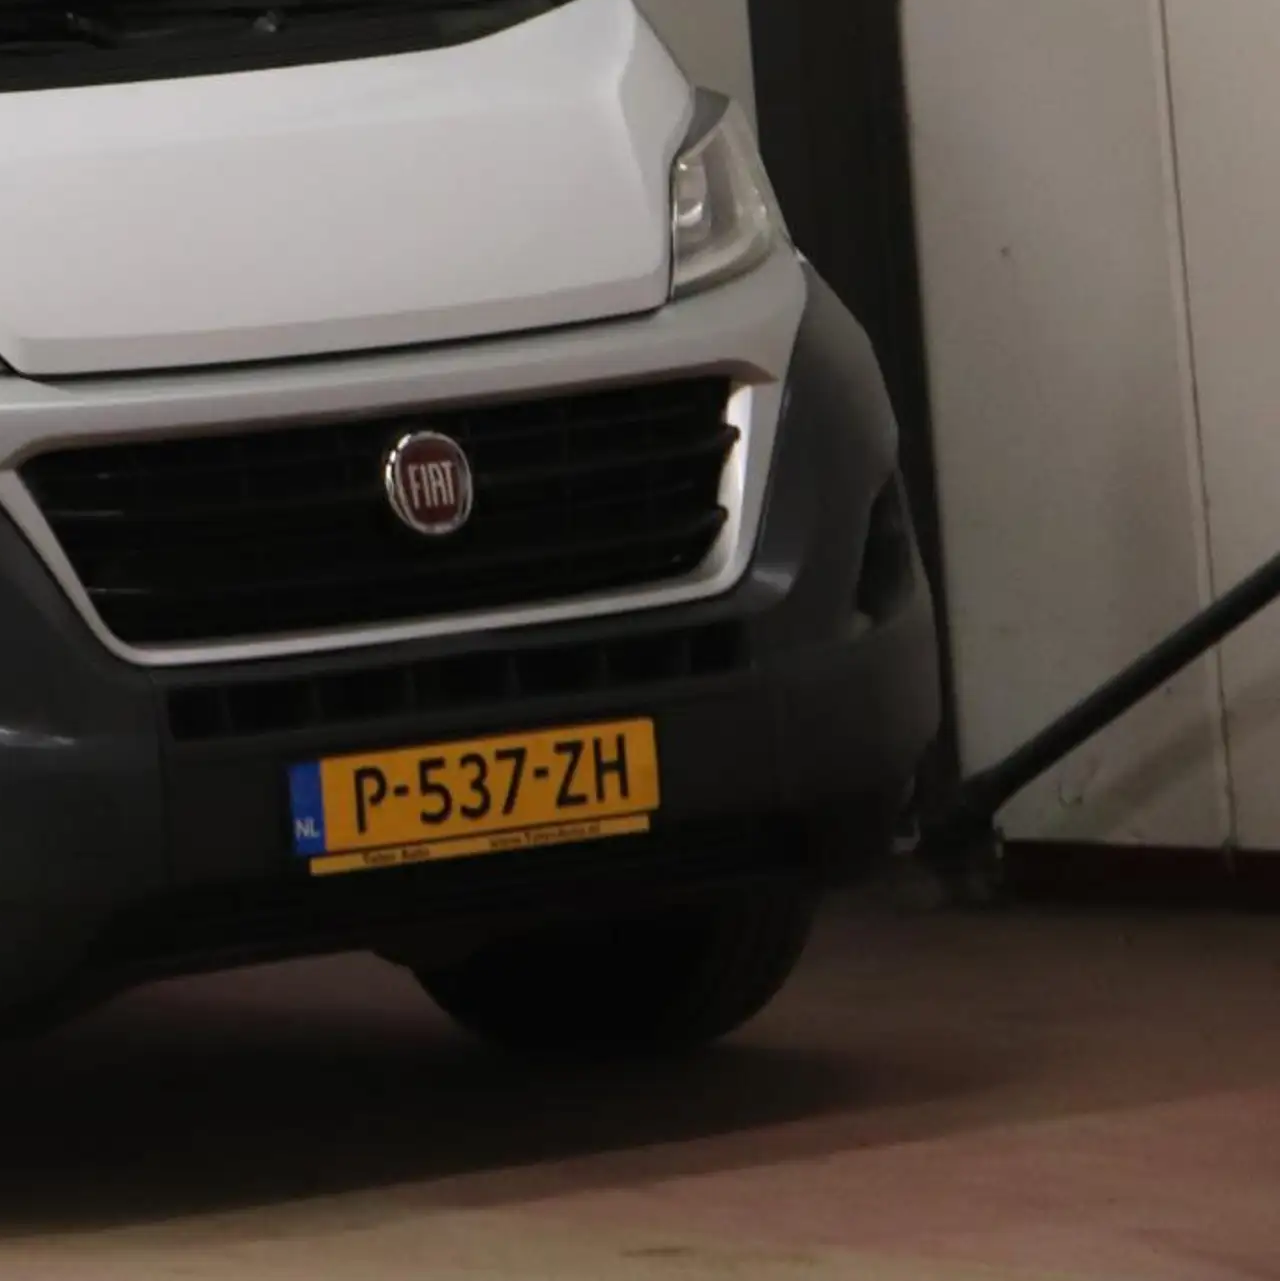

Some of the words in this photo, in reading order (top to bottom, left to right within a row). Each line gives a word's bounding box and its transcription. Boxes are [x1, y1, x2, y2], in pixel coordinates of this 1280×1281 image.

[409, 461, 454, 510] FIAT
[353, 733, 629, 835] P-537-ZH
[295, 817, 320, 840] NL
